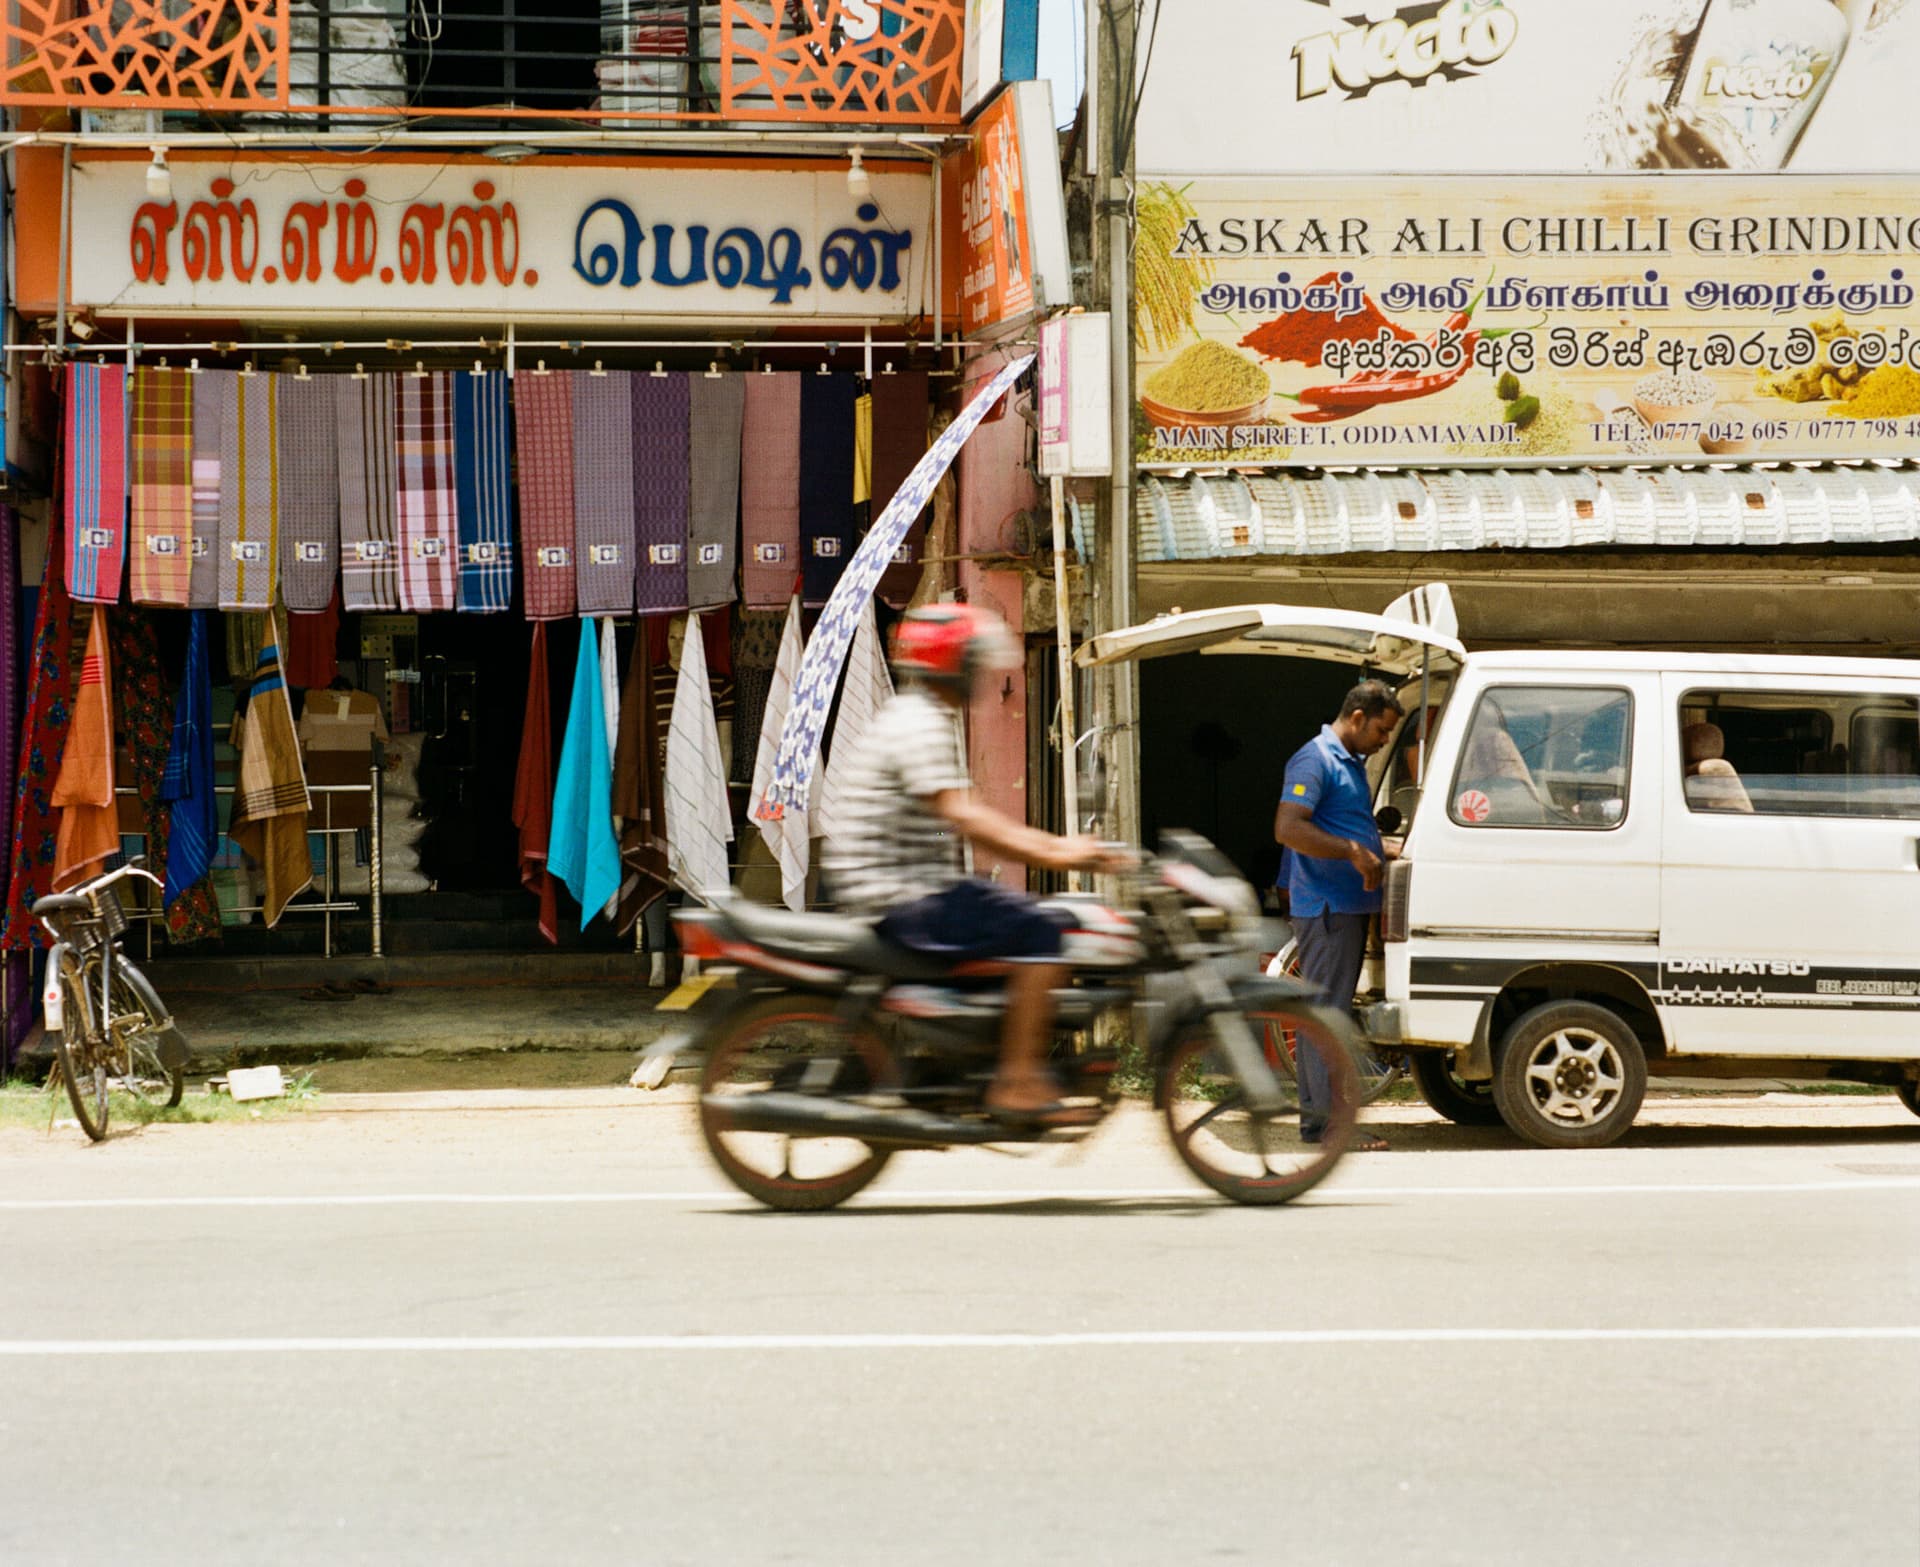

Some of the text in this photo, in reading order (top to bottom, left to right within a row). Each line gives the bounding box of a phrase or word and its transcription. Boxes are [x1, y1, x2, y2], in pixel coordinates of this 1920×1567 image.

[1290, 0, 1519, 102] Necto
[130, 178, 912, 304] எஸ்.எம்.எஸ். பெஷன்
[1176, 218, 1370, 253] ASKAR
[1391, 218, 1483, 252] ALI
[1502, 217, 1670, 252] CHILLI
[1201, 268, 1914, 319] அஸ்கர் அலி மிளகாய் அரைக்கும்
[1323, 328, 1462, 378] අස්කර්
[1476, 331, 1534, 377] අලි
[1549, 327, 1649, 368] මිරිස්
[1657, 328, 1816, 376] ඇඹරුම්
[1157, 422, 1521, 447] MAIN STREET, ODDAMAVADI.
[1589, 423, 1645, 442] TEL:
[1653, 422, 1702, 441] 0777
[1709, 421, 1745, 441] 042
[1752, 420, 1788, 440] 605
[1809, 420, 1857, 439] 0777
[1864, 420, 1898, 439] 798
[1666, 957, 1811, 976] DAIHATSU
